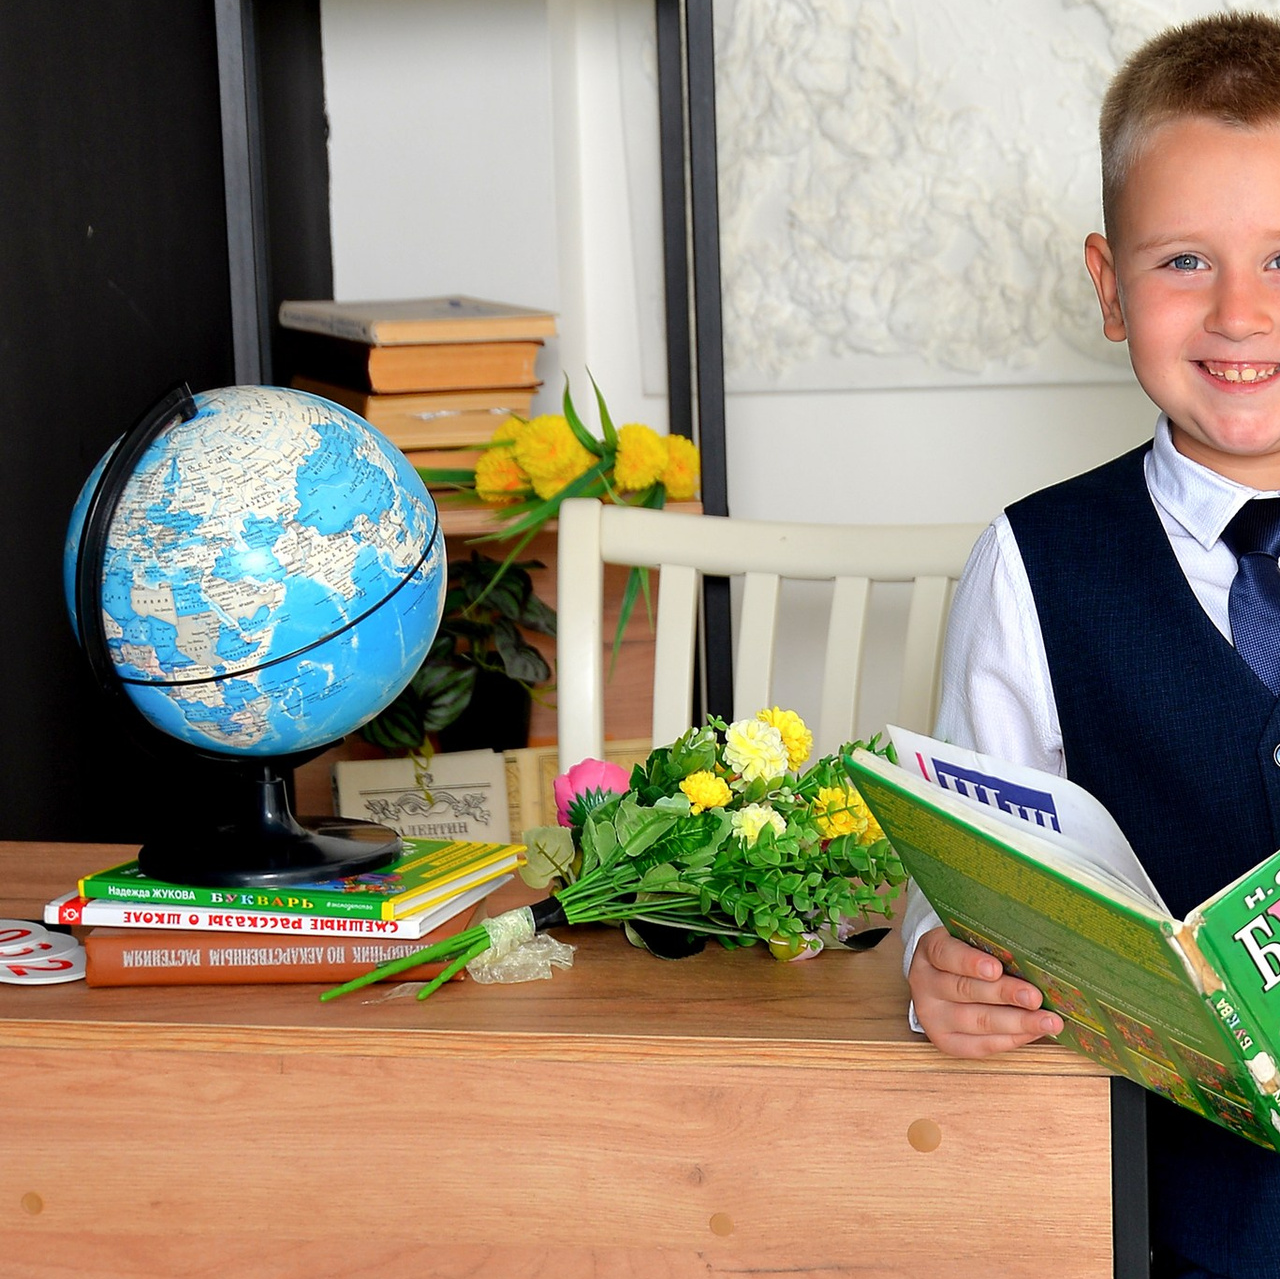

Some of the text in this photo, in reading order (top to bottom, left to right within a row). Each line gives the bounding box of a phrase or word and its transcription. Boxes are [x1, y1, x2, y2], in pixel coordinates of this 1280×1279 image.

[108, 885, 196, 900] Надежда ЖУКОВА
[210, 892, 314, 909] БУКВАРЬ
[1243, 887, 1273, 909] Н.
[310, 918, 399, 933] СМЕШНЫЕ
[123, 948, 201, 968] РАСТЕНИЯМ
[208, 946, 324, 967] ЛЕКАРСТВЕННЫМ
[326, 946, 345, 964] ПО
